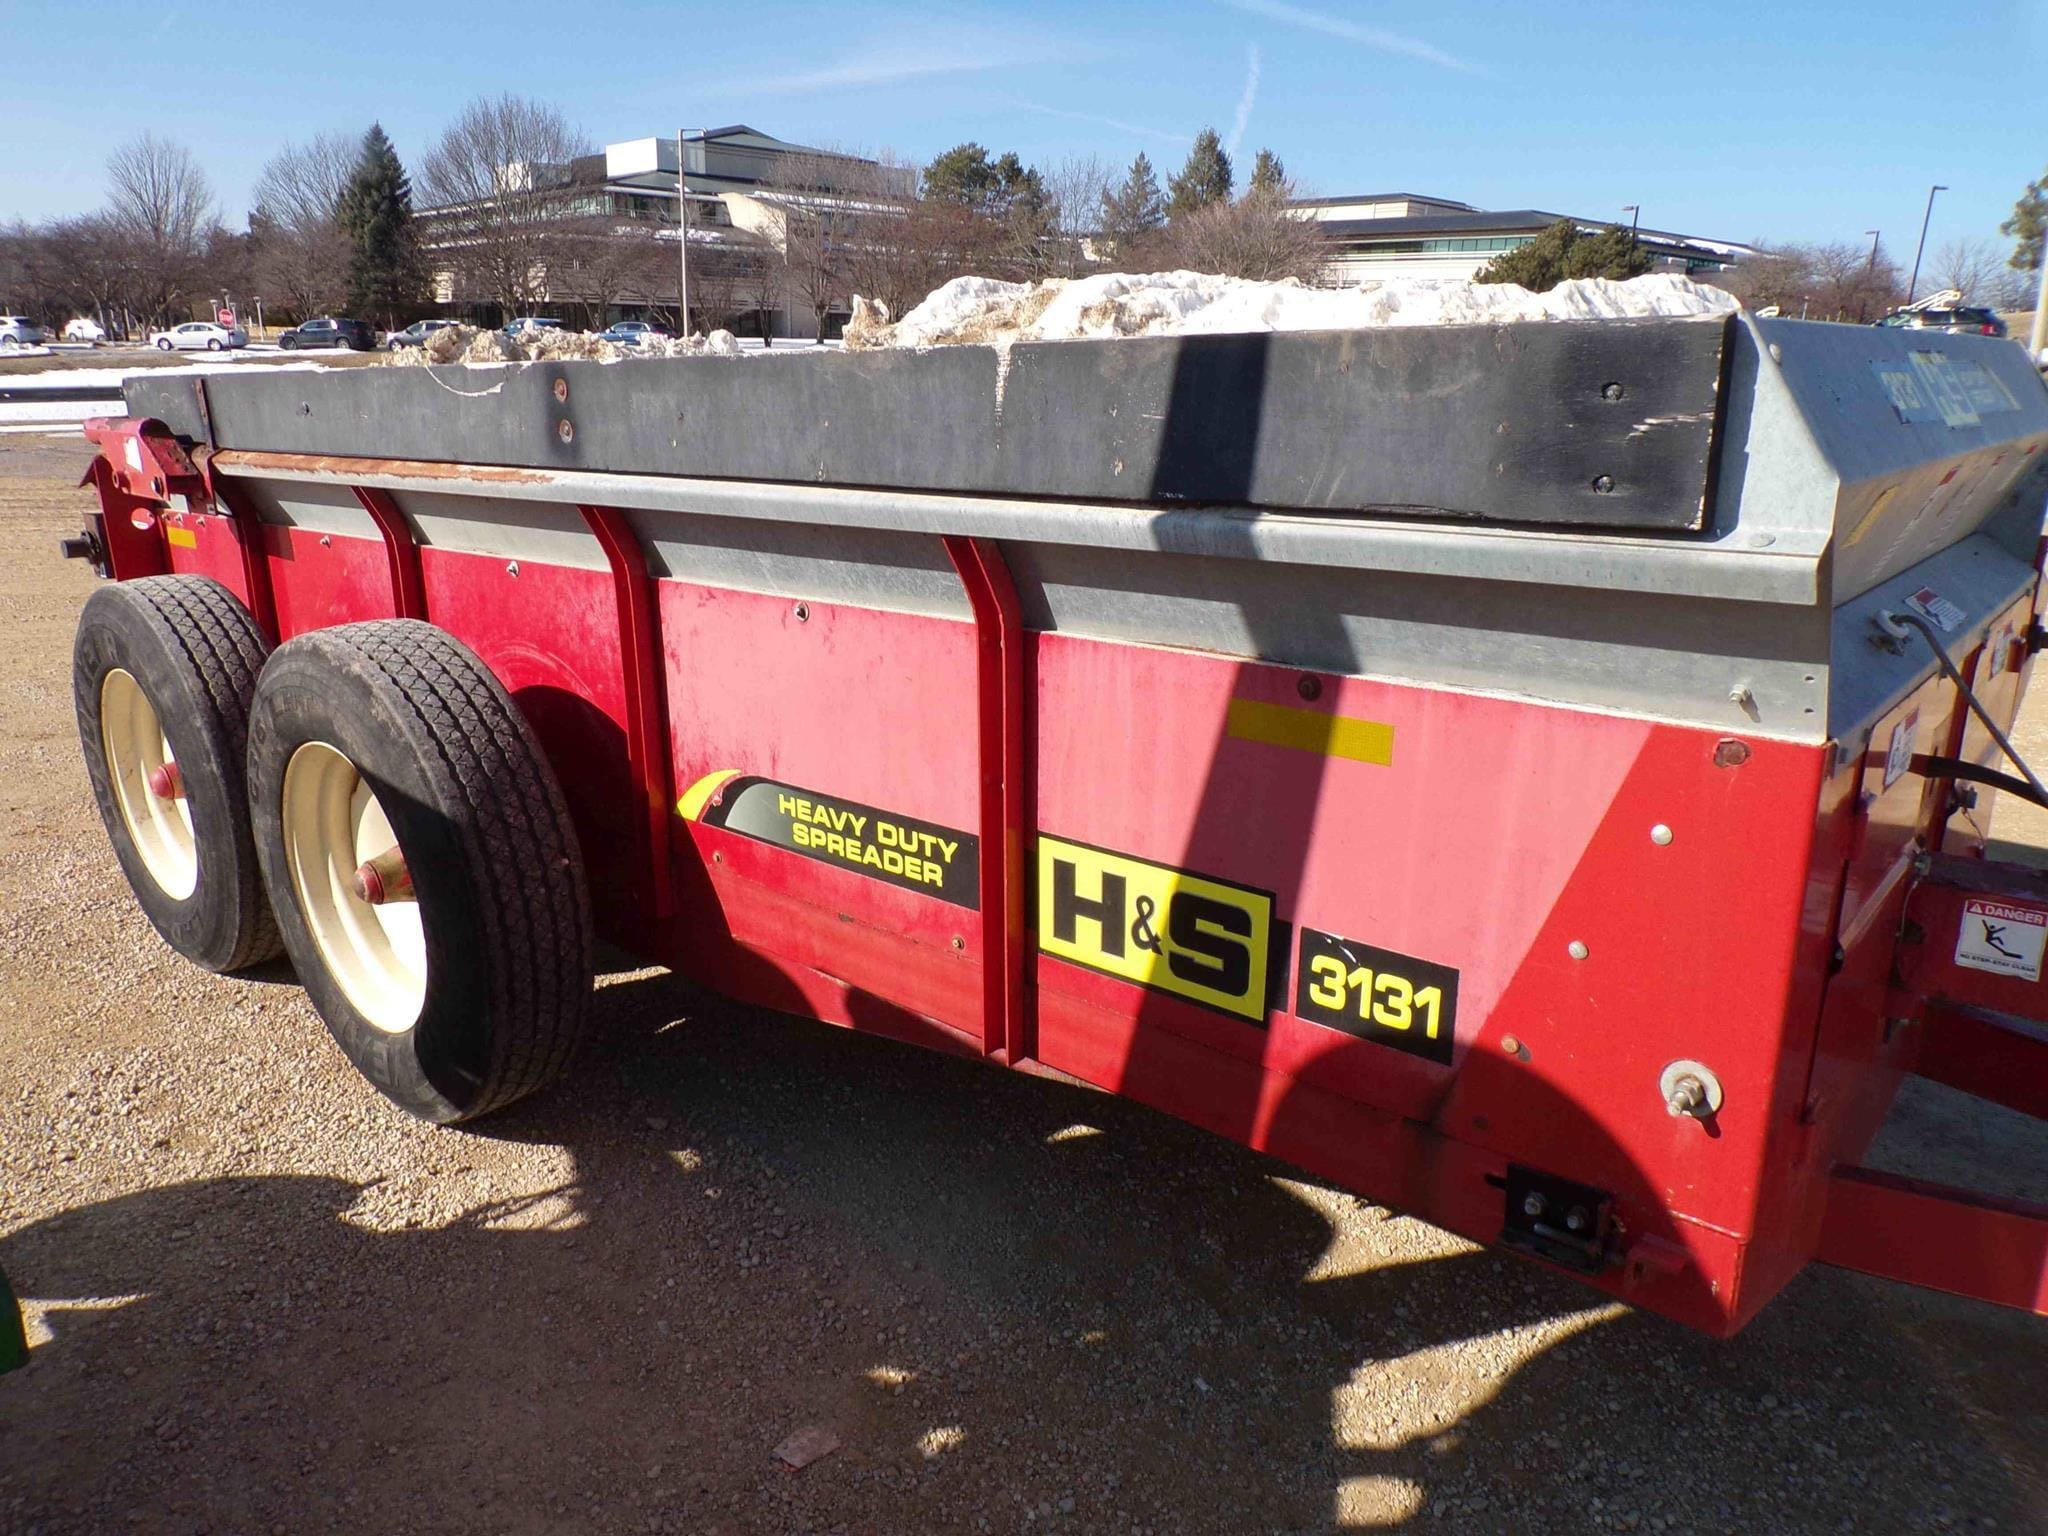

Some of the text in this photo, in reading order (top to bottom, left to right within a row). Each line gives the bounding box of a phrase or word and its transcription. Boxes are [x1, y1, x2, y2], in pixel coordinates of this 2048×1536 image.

[779, 793, 958, 863] HEAVY DUTY
[792, 822, 943, 888] SPREADER
[1052, 856, 1253, 998] H&S
[1985, 905, 2044, 925] DANGER
[1309, 954, 1442, 1040] 3131
